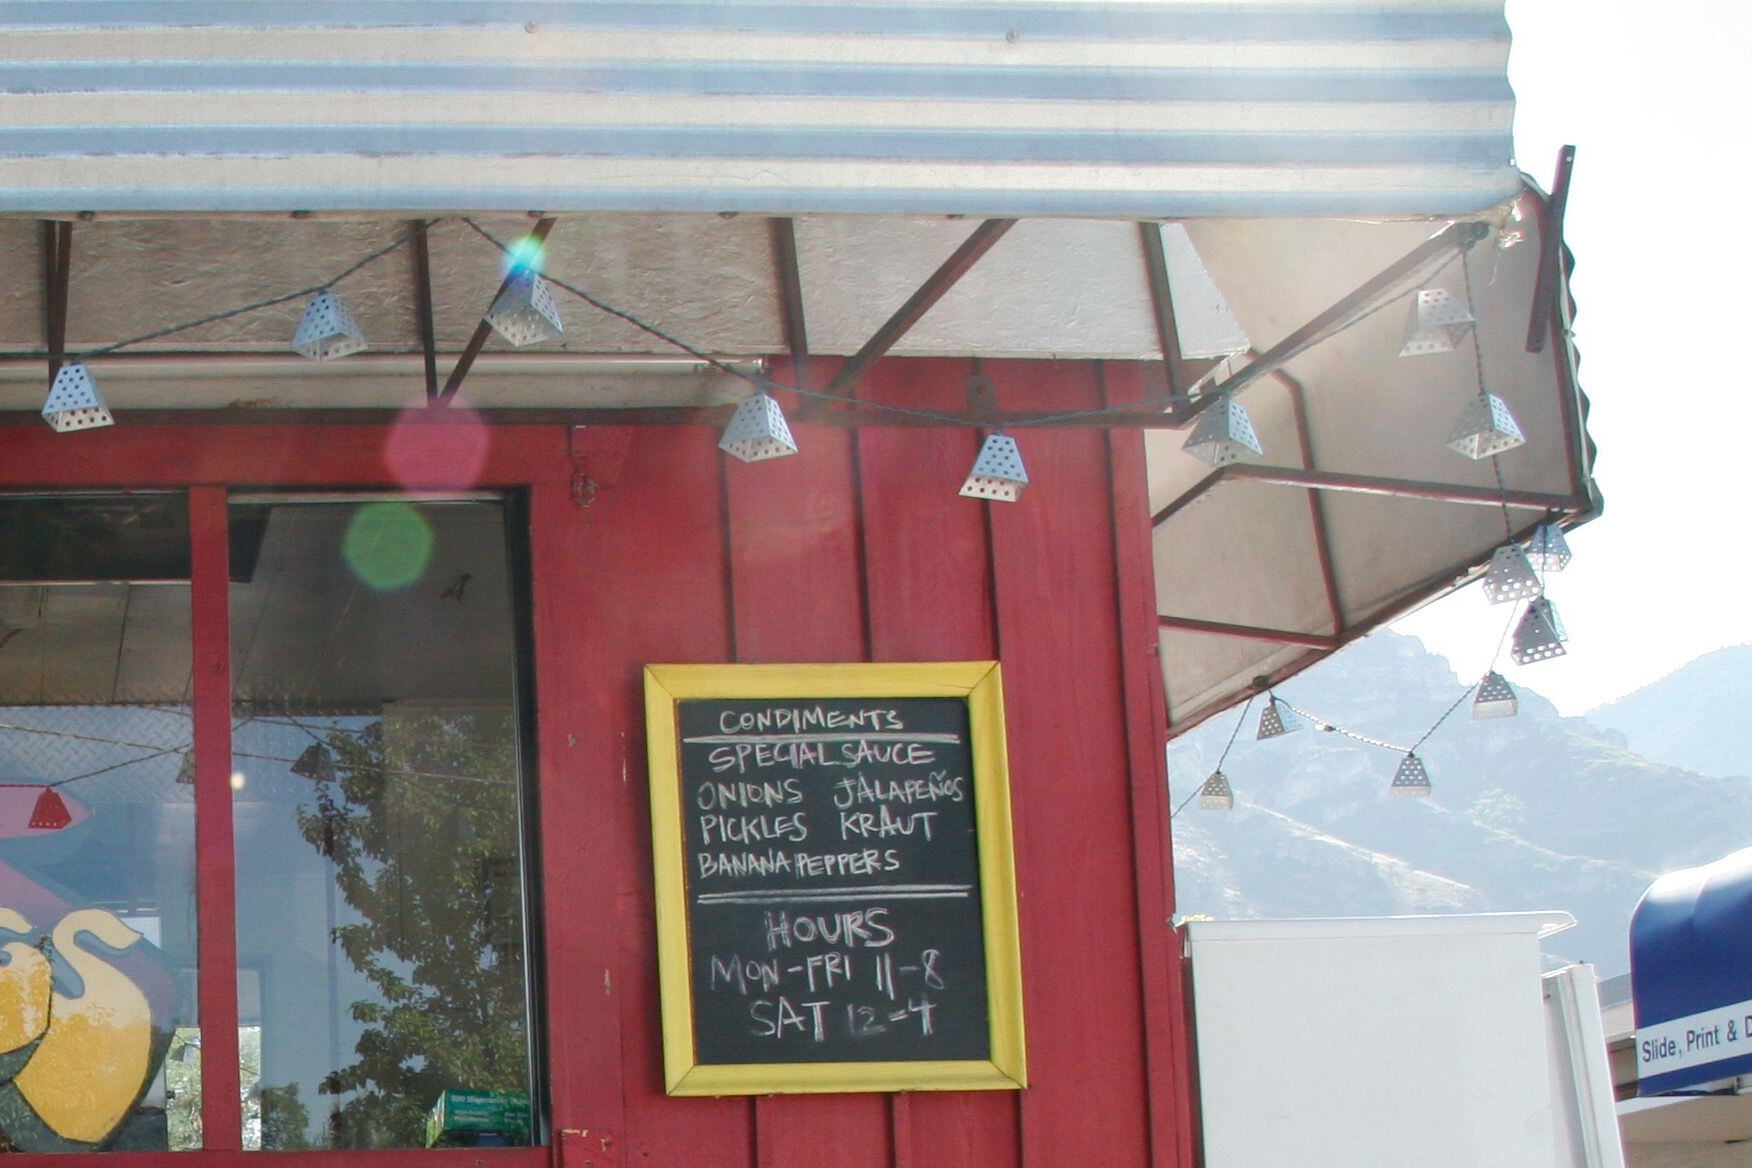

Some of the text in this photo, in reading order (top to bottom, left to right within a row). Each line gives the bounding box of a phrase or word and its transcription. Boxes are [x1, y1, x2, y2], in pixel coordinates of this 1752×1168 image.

[719, 707, 904, 734] CONDIMENTS
[709, 739, 936, 773] SPECIAL SAUCE
[698, 769, 964, 810] ONIONS JALAPEÑOS
[700, 804, 938, 845] PICKLES KRAUT
[698, 847, 900, 879] BANANA PEPPERS
[764, 907, 894, 951] HOURS
[750, 996, 831, 1043] SAT
[1642, 1036, 1682, 1063] Slide,
[1687, 1025, 1720, 1052] Print
[1727, 1019, 1737, 1042] &
